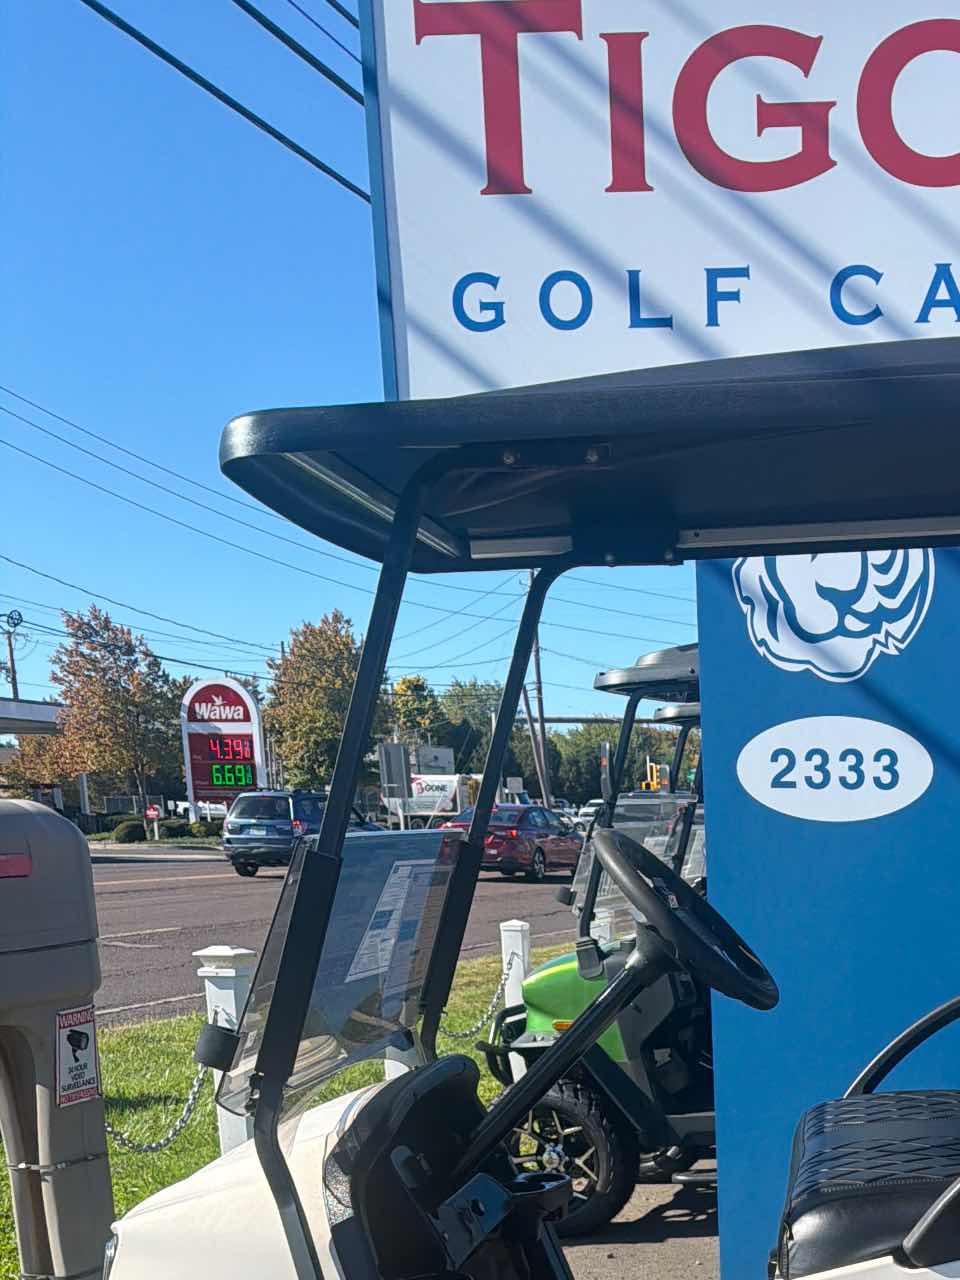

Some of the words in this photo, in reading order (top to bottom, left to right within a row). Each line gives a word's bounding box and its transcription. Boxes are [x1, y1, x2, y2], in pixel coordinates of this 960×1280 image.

[451, 265, 751, 333] GOLF
[194, 702, 244, 720] Wawa
[769, 747, 900, 791] 2333
